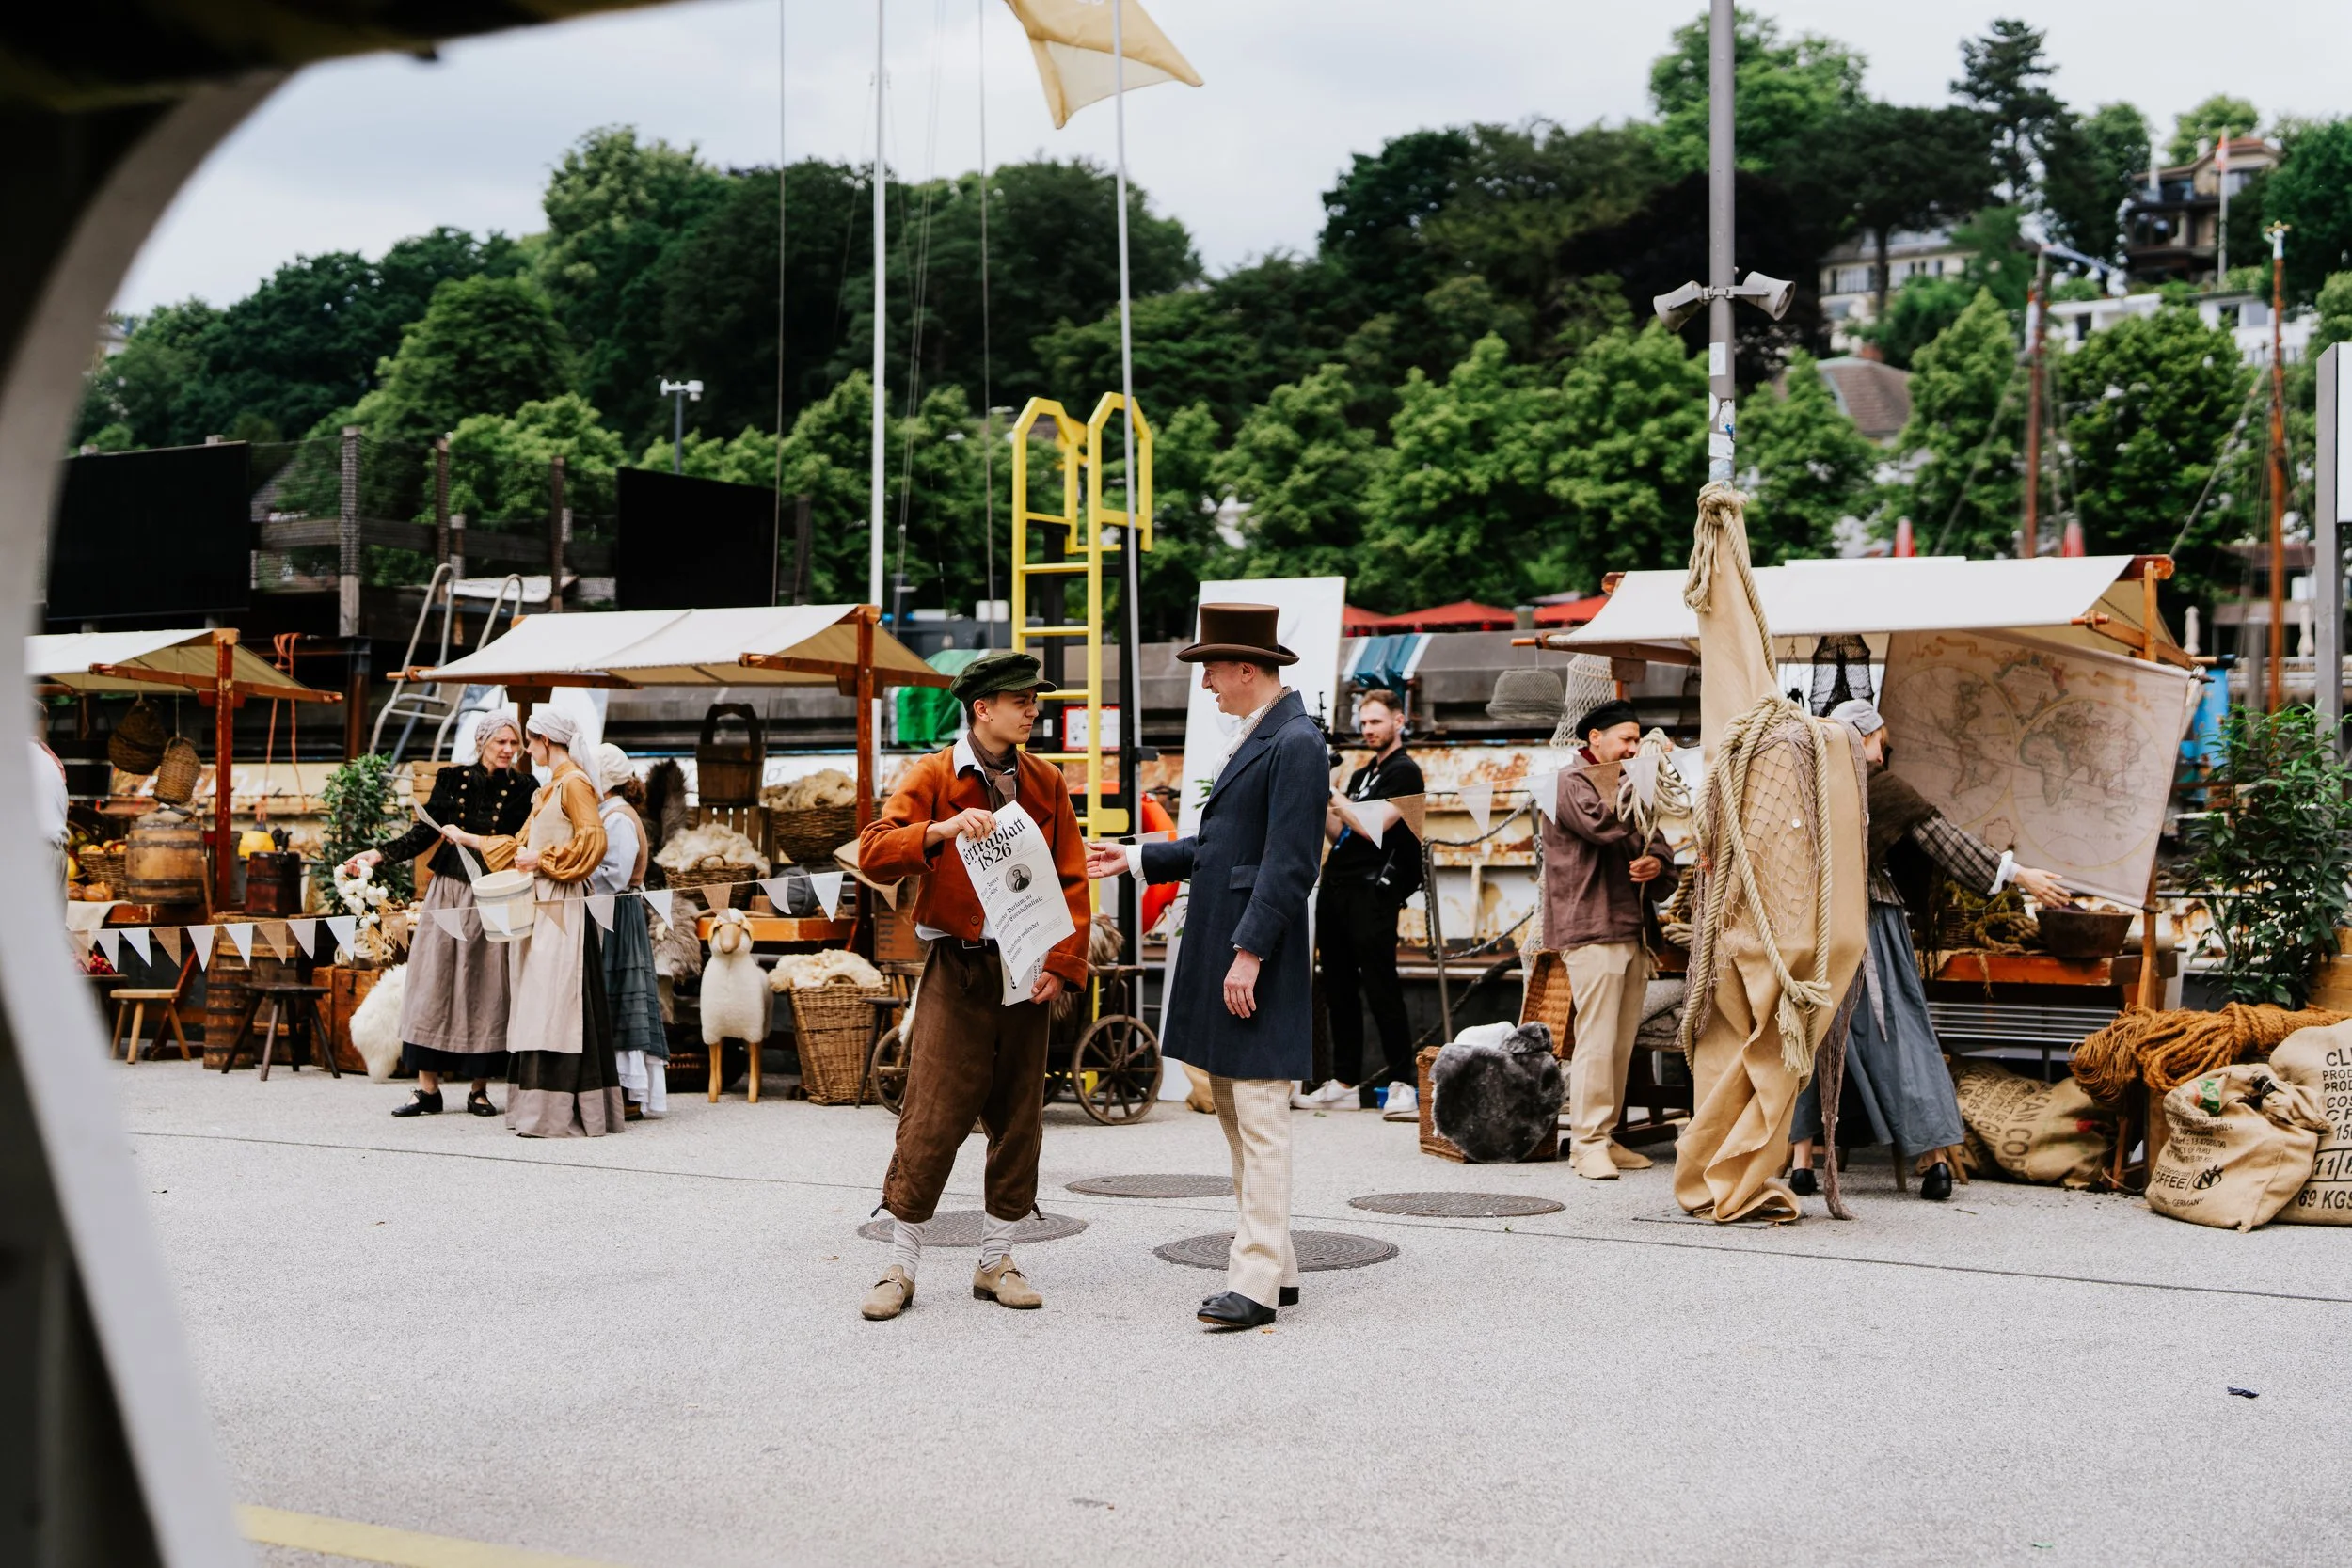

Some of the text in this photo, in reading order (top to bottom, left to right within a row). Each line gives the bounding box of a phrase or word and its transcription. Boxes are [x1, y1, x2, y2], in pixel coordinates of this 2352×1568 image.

[978, 842, 1012, 872] 1826
[2326, 1047, 2352, 1067] CL
[2335, 1123, 2352, 1141] 15
[2171, 1196, 2205, 1208] GERMANY
[2298, 1189, 2352, 1209] 69 KGS
